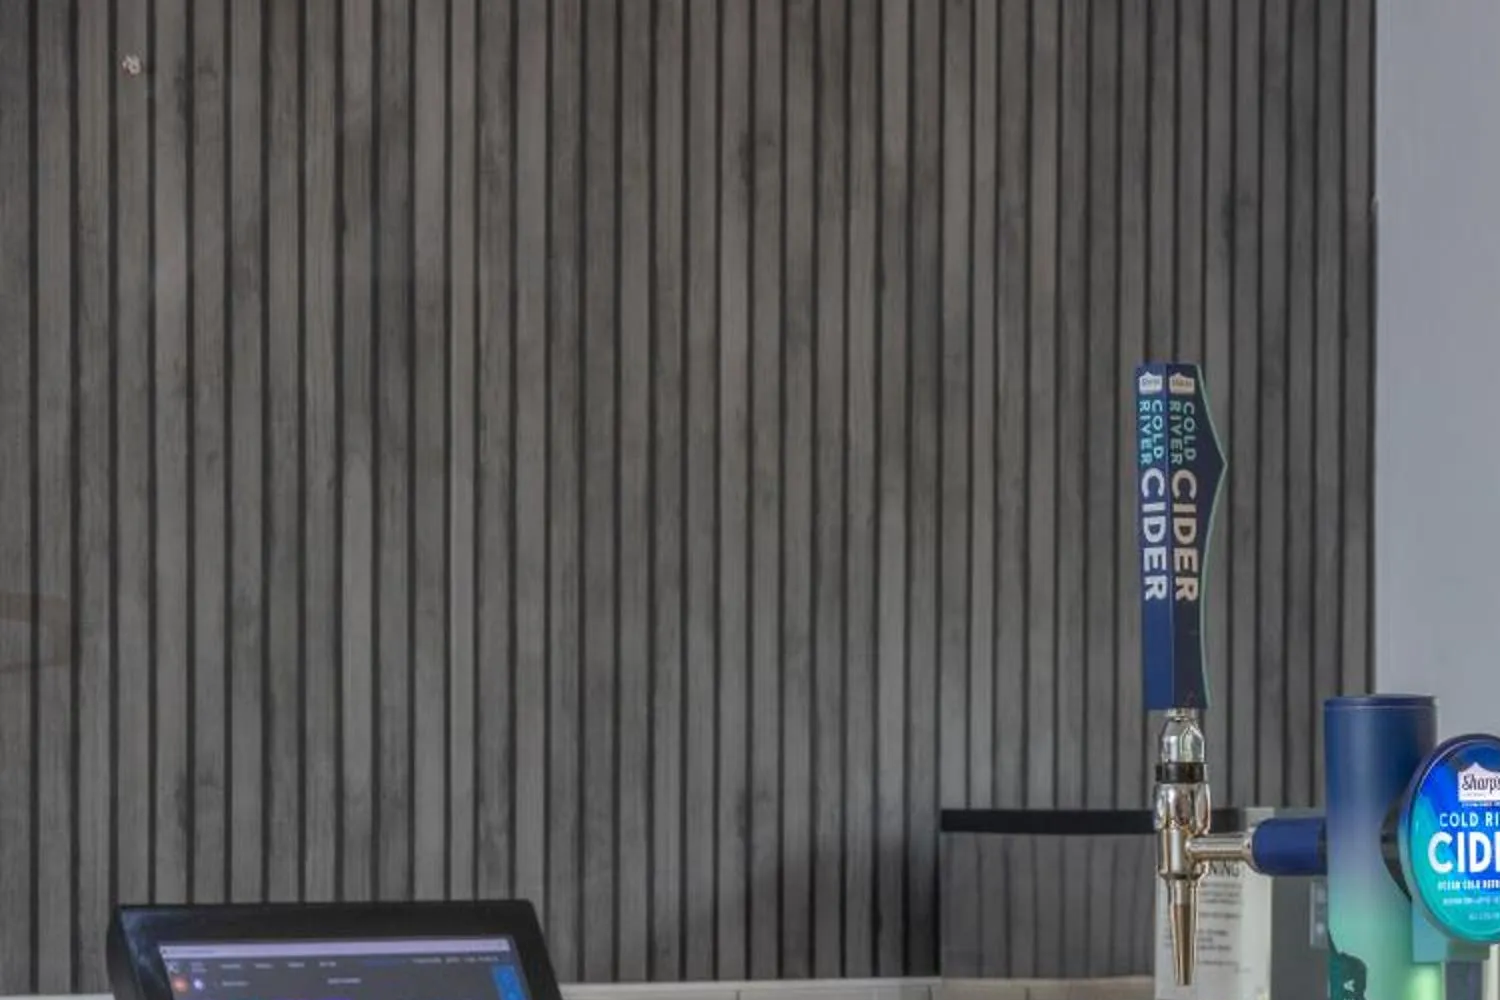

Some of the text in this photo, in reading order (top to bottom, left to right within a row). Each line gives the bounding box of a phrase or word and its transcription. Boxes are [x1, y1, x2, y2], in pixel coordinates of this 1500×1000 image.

[1139, 400, 1153, 466] RIVER
[1152, 399, 1165, 459] COLD
[1169, 400, 1183, 466] RIVER
[1182, 402, 1197, 461] COLD
[1141, 467, 1168, 600] CIDER
[1171, 469, 1198, 601] CIDER
[1439, 812, 1479, 828] COLD
